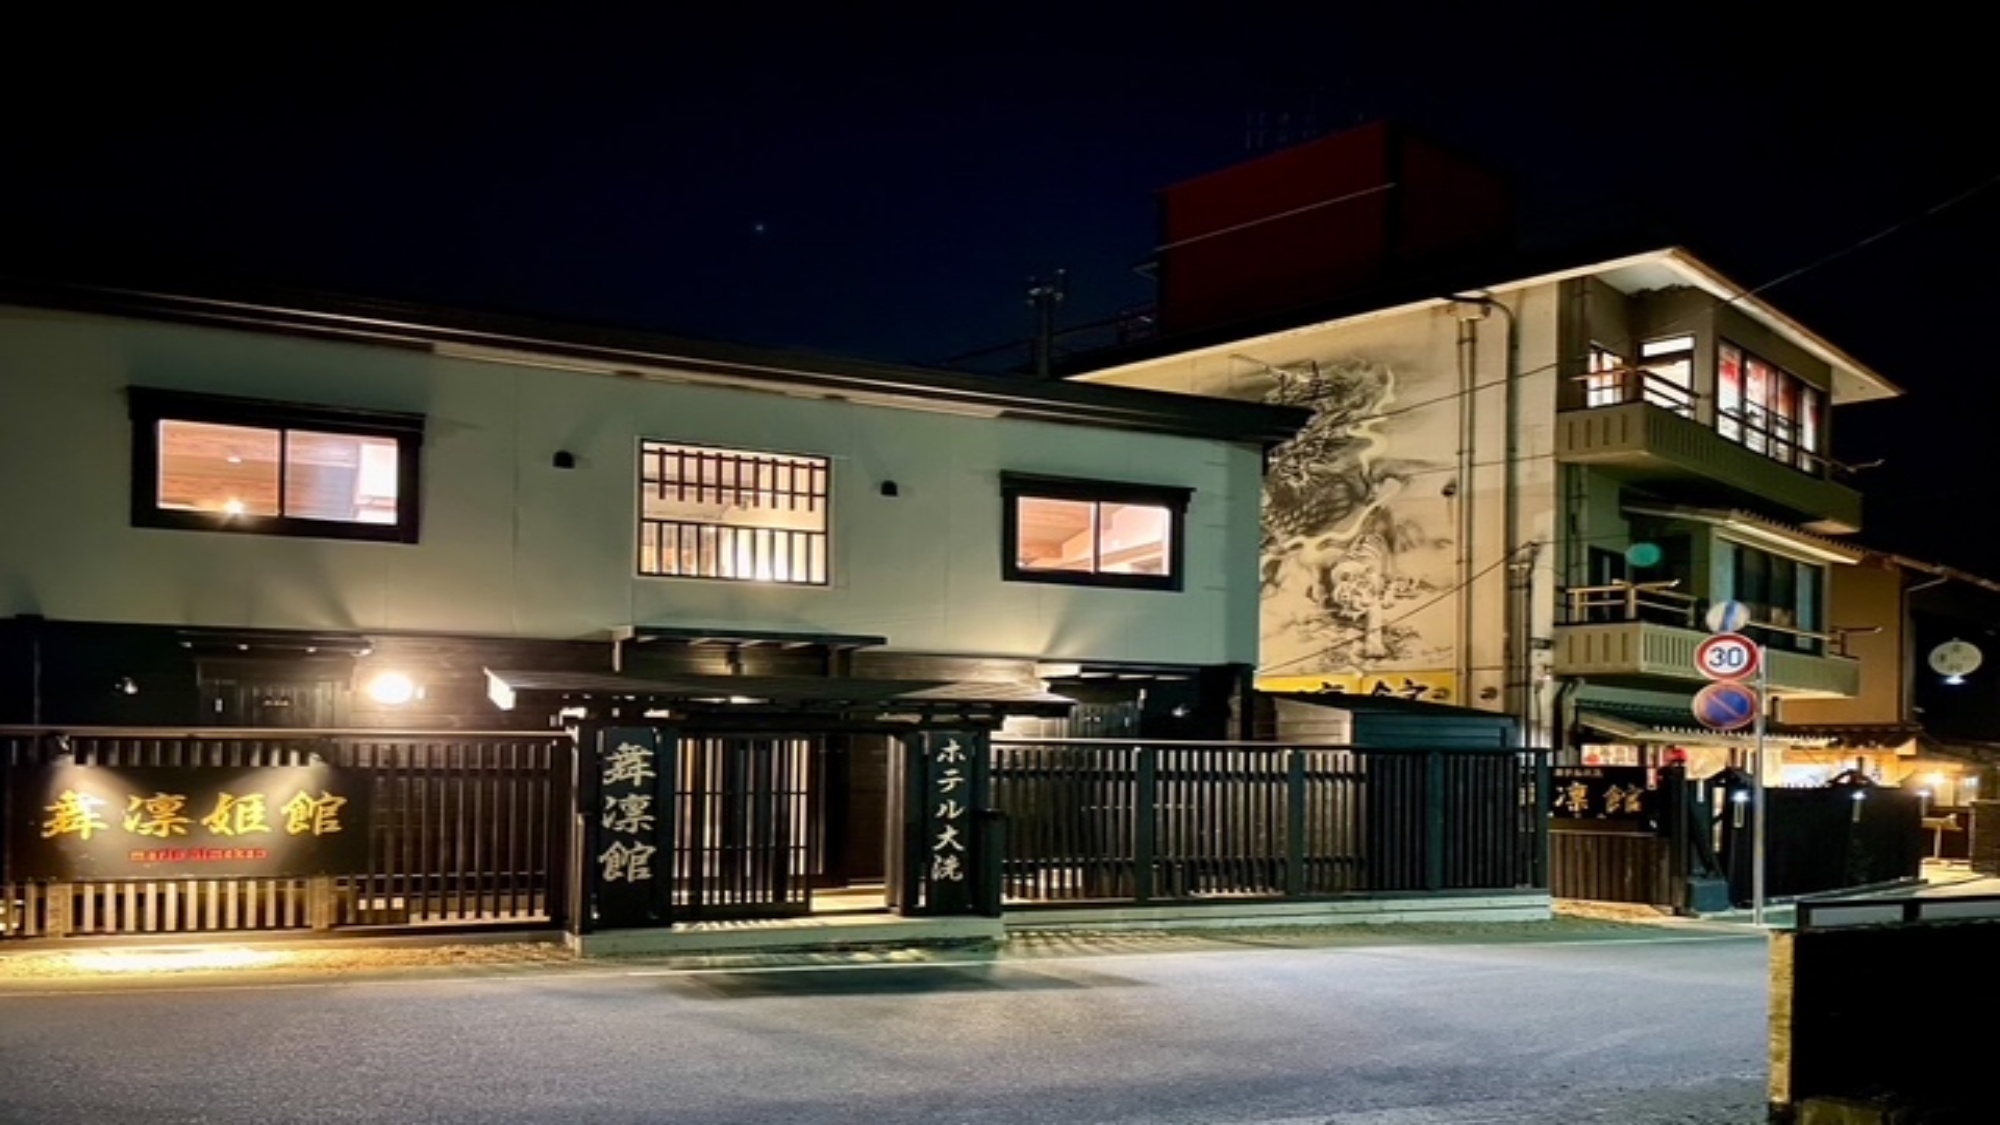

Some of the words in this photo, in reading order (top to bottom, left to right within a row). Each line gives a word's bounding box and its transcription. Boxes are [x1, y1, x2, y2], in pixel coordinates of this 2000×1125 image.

[1708, 646, 1744, 668] 30
[930, 738, 967, 881] ホテル大洗
